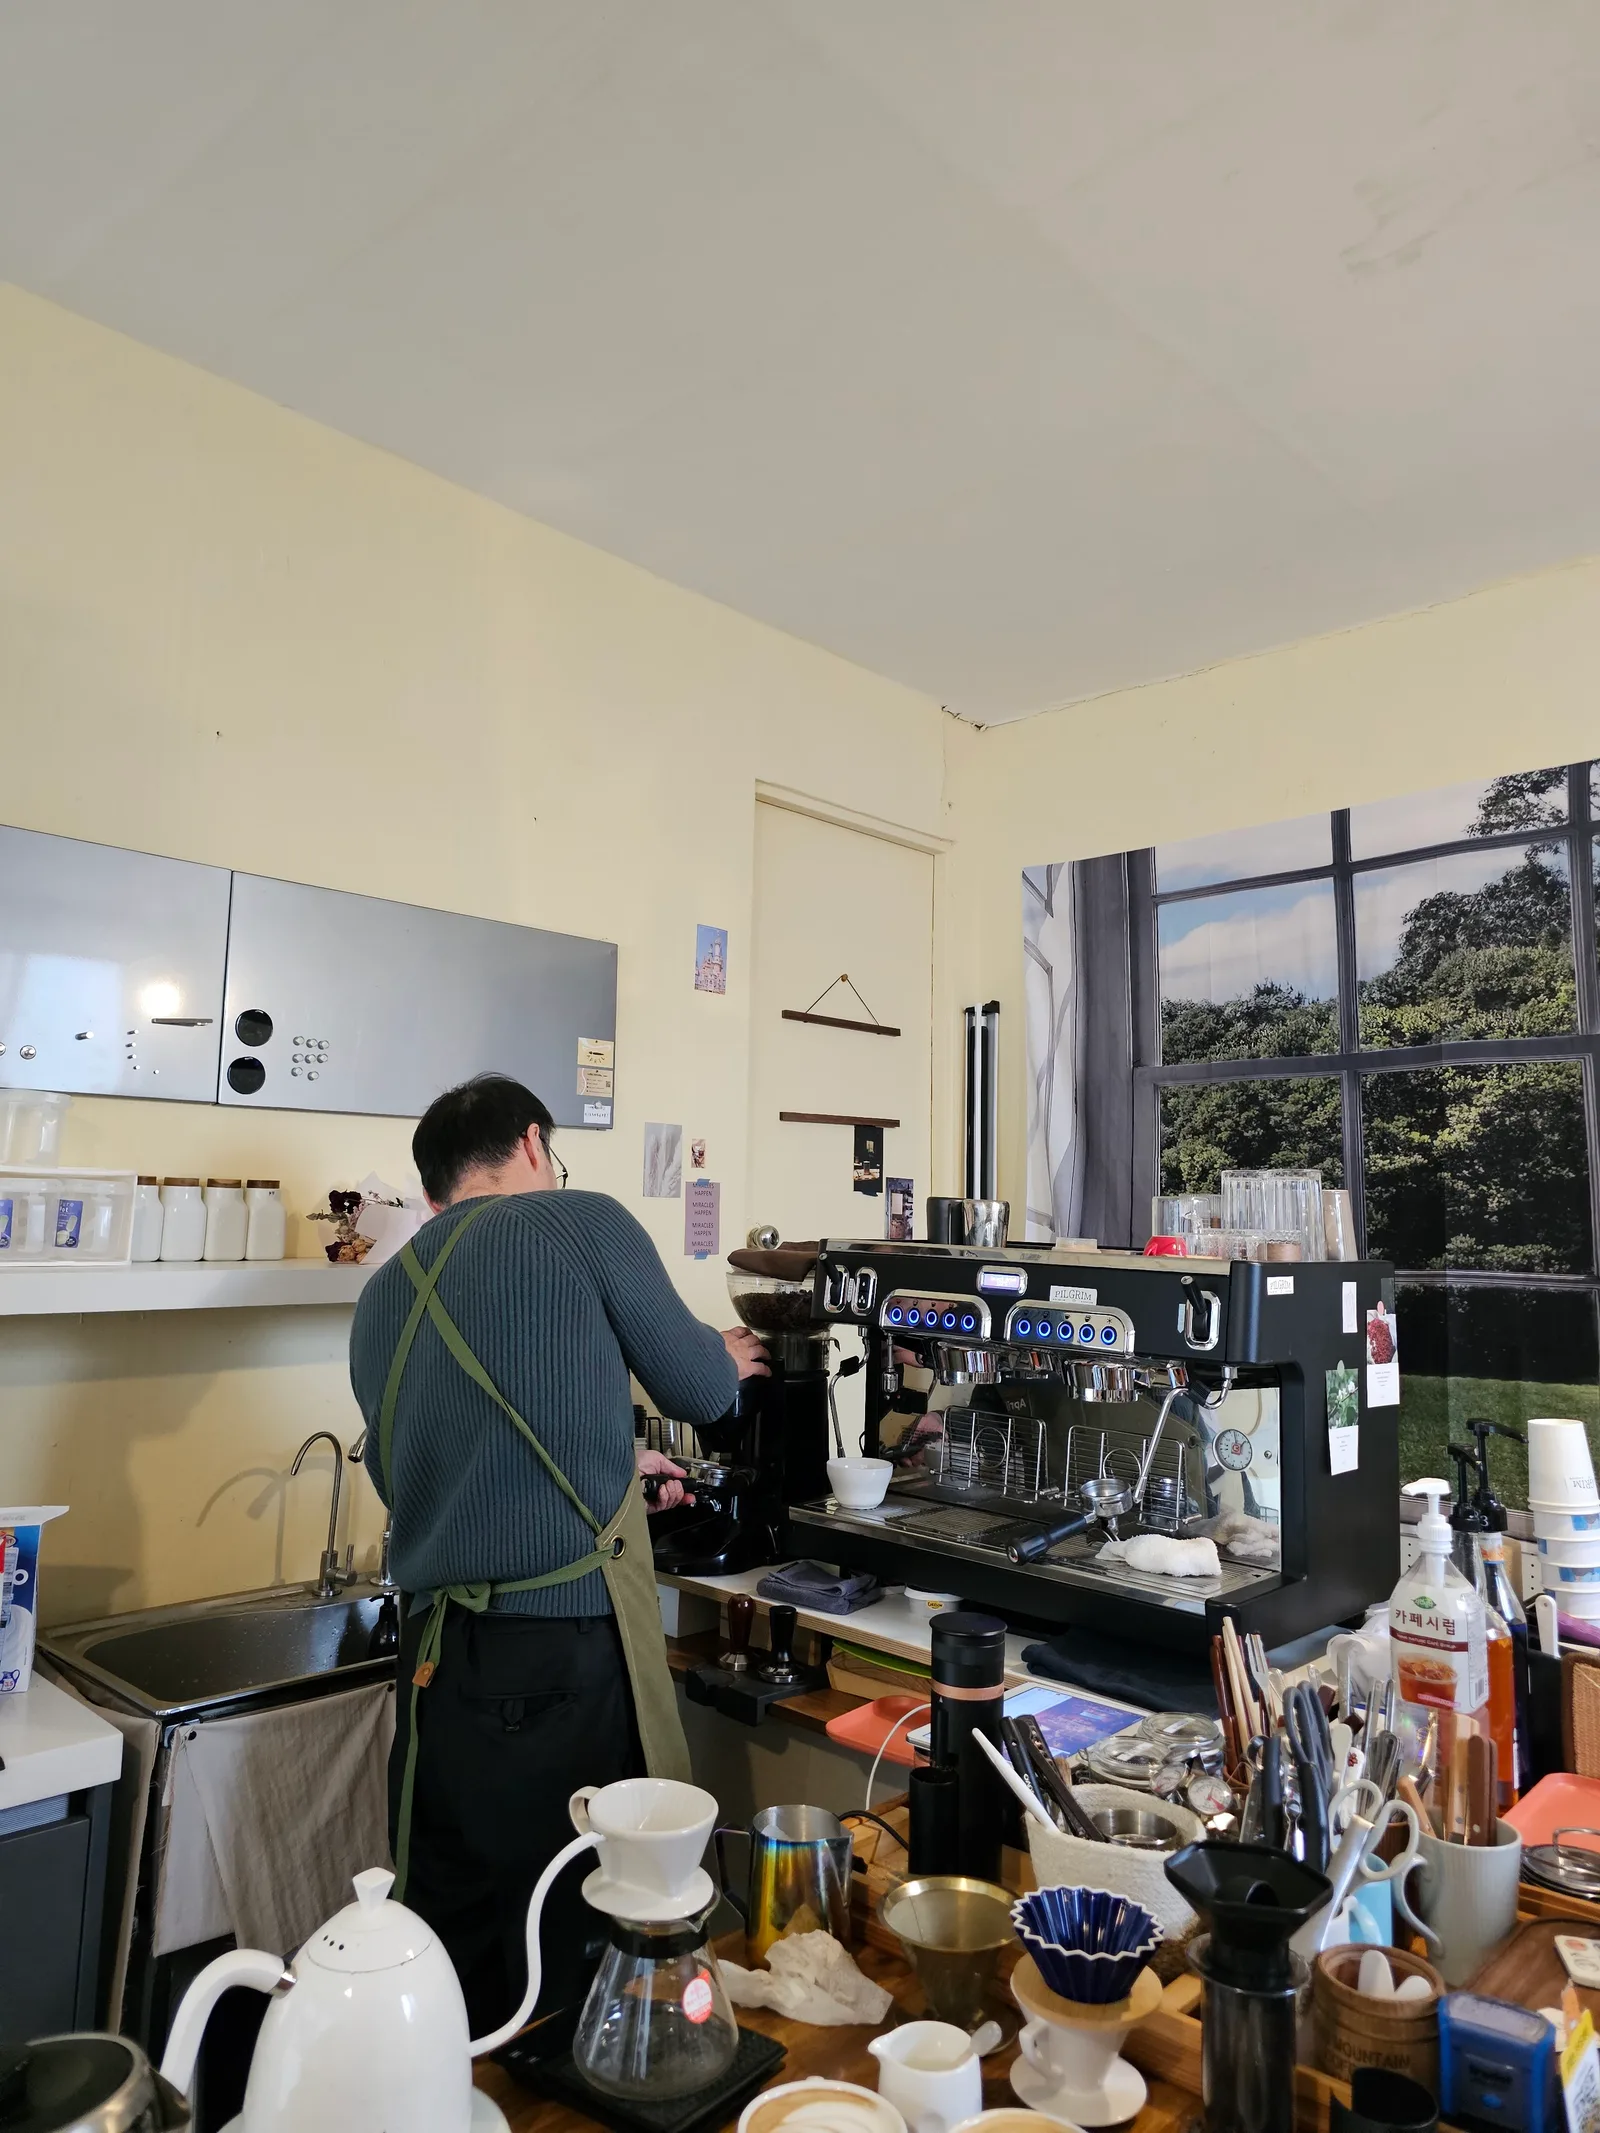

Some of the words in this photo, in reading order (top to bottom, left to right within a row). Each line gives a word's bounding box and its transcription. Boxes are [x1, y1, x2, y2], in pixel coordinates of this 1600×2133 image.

[1055, 1289, 1092, 1301] PILGRIM
[1480, 1515, 1489, 1527] 3
[1395, 1609, 1456, 1636] 카페시럽
[1332, 2037, 1411, 2070] MOUNTAIN
